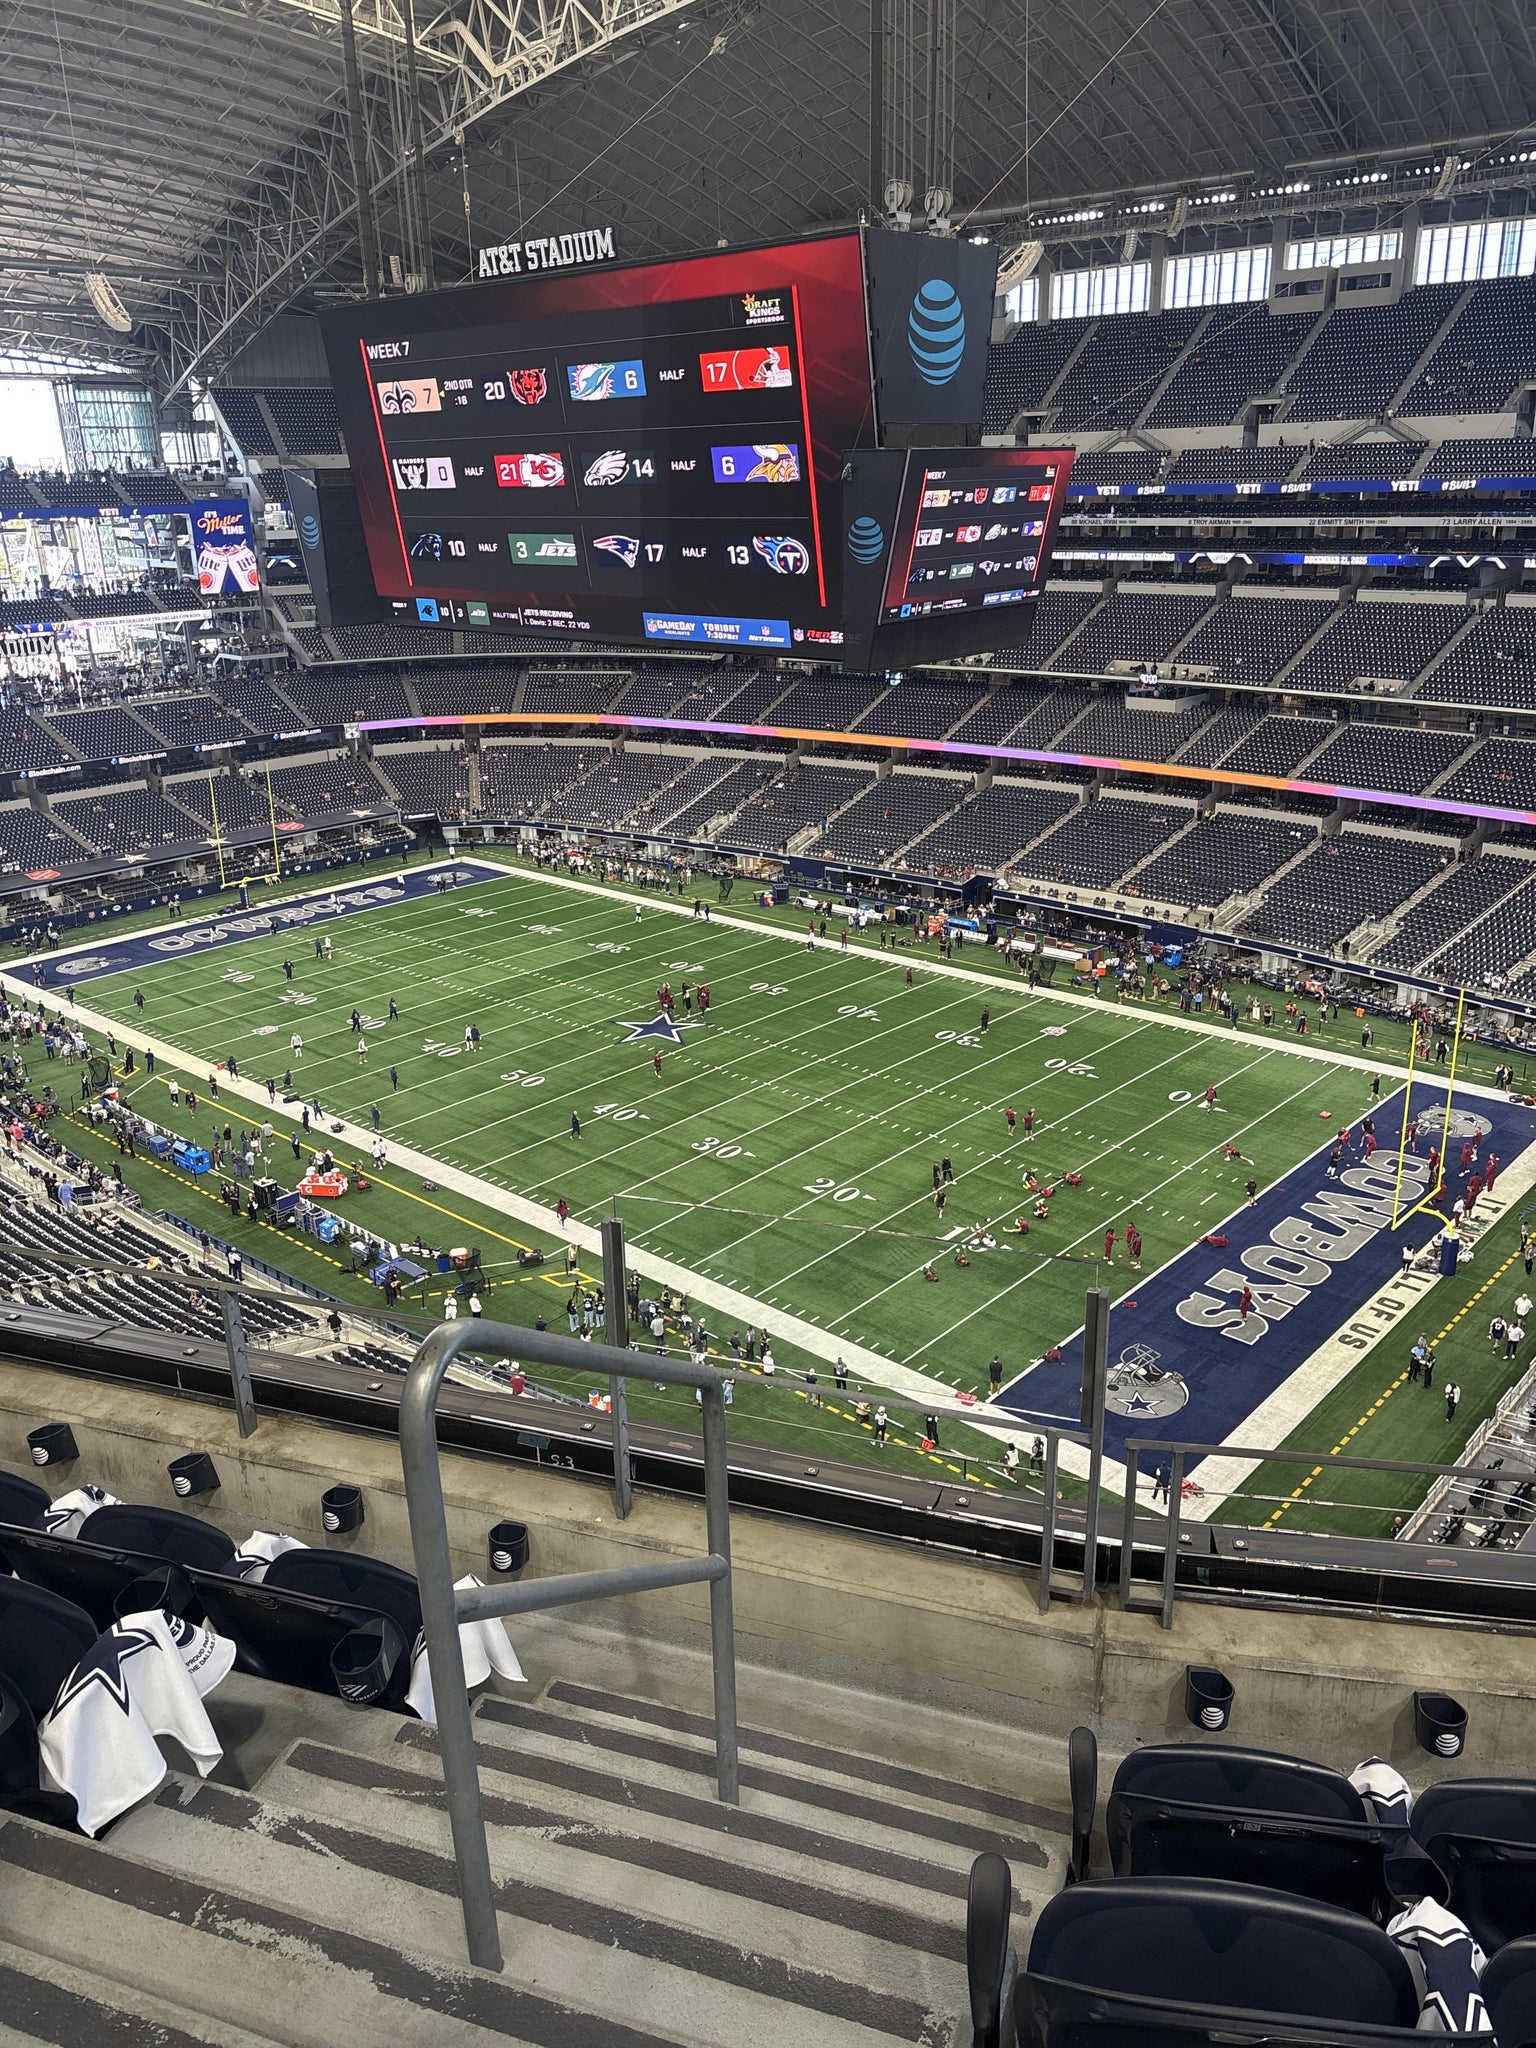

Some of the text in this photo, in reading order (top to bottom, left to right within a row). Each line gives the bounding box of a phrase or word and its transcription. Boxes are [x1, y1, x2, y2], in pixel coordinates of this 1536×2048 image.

[478, 227, 616, 277] AT&T STADIUM
[745, 299, 780, 311] DRAFT
[749, 307, 781, 317] KINGS
[746, 316, 785, 325] SPORTSBOOK
[367, 341, 410, 360] WEEK 7
[659, 369, 685, 381] HALF
[707, 362, 728, 383] 17
[444, 379, 473, 391] 2ND QTR
[624, 371, 638, 390] 6
[423, 388, 431, 404] 7
[484, 381, 506, 401] 20
[464, 466, 485, 477] HALF
[500, 463, 518, 481] 21
[632, 458, 655, 478] 14
[671, 460, 697, 471] HALF
[721, 456, 736, 476] 6
[438, 466, 448, 481] 0
[1097, 486, 1120, 495] YETI
[1236, 484, 1261, 494] YETI
[1391, 480, 1420, 492] YETI
[965, 493, 974, 502] 20
[1009, 489, 1014, 499] 6
[99, 508, 119, 516] YETI
[197, 514, 243, 534] Miller
[221, 526, 246, 535] TIME
[957, 529, 965, 539] 21
[448, 540, 466, 557] 10
[478, 543, 498, 552] HALF
[516, 541, 528, 558] 3
[534, 542, 577, 558] JETS
[644, 544, 664, 562] 17
[682, 547, 707, 558] HALF
[727, 545, 750, 565] 13
[1051, 551, 1074, 559] DALLAS
[200, 556, 221, 571] Lite
[236, 554, 257, 571] Lite
[1351, 556, 1368, 565] 2025
[926, 570, 934, 580] 10
[440, 606, 449, 617] 10
[457, 607, 464, 618] 3
[524, 608, 574, 619] JETS RECEIVING
[530, 619, 547, 627] Davis:
[553, 621, 567, 629] REC,
[577, 622, 591, 630] YDS
[703, 623, 740, 633] TONIGHT
[749, 635, 785, 643] NETWORK
[280, 728, 321, 739] Blockchain.com
[201, 740, 246, 751] Blockchain.com
[119, 752, 167, 764] Blockchain.com
[28, 766, 81, 778] Blockchain.com
[148, 885, 406, 952] COWBOYS
[226, 969, 255, 984] 10
[836, 1004, 880, 1022] 40
[934, 1030, 976, 1048] 30
[422, 1038, 462, 1057] 40
[1044, 1058, 1096, 1076] 20
[500, 1069, 546, 1087] 50
[592, 1101, 639, 1122] 40
[691, 1136, 743, 1160] 30
[305, 1186, 313, 1194] G
[802, 1177, 861, 1203] 20
[1175, 1149, 1446, 1346] COWBOYS
[1369, 1297, 1406, 1322] OF
[1337, 1323, 1381, 1350] US
[185, 1648, 205, 1667] PROUD
[188, 1664, 201, 1674] THE
[199, 1641, 215, 1666] DALLAS
